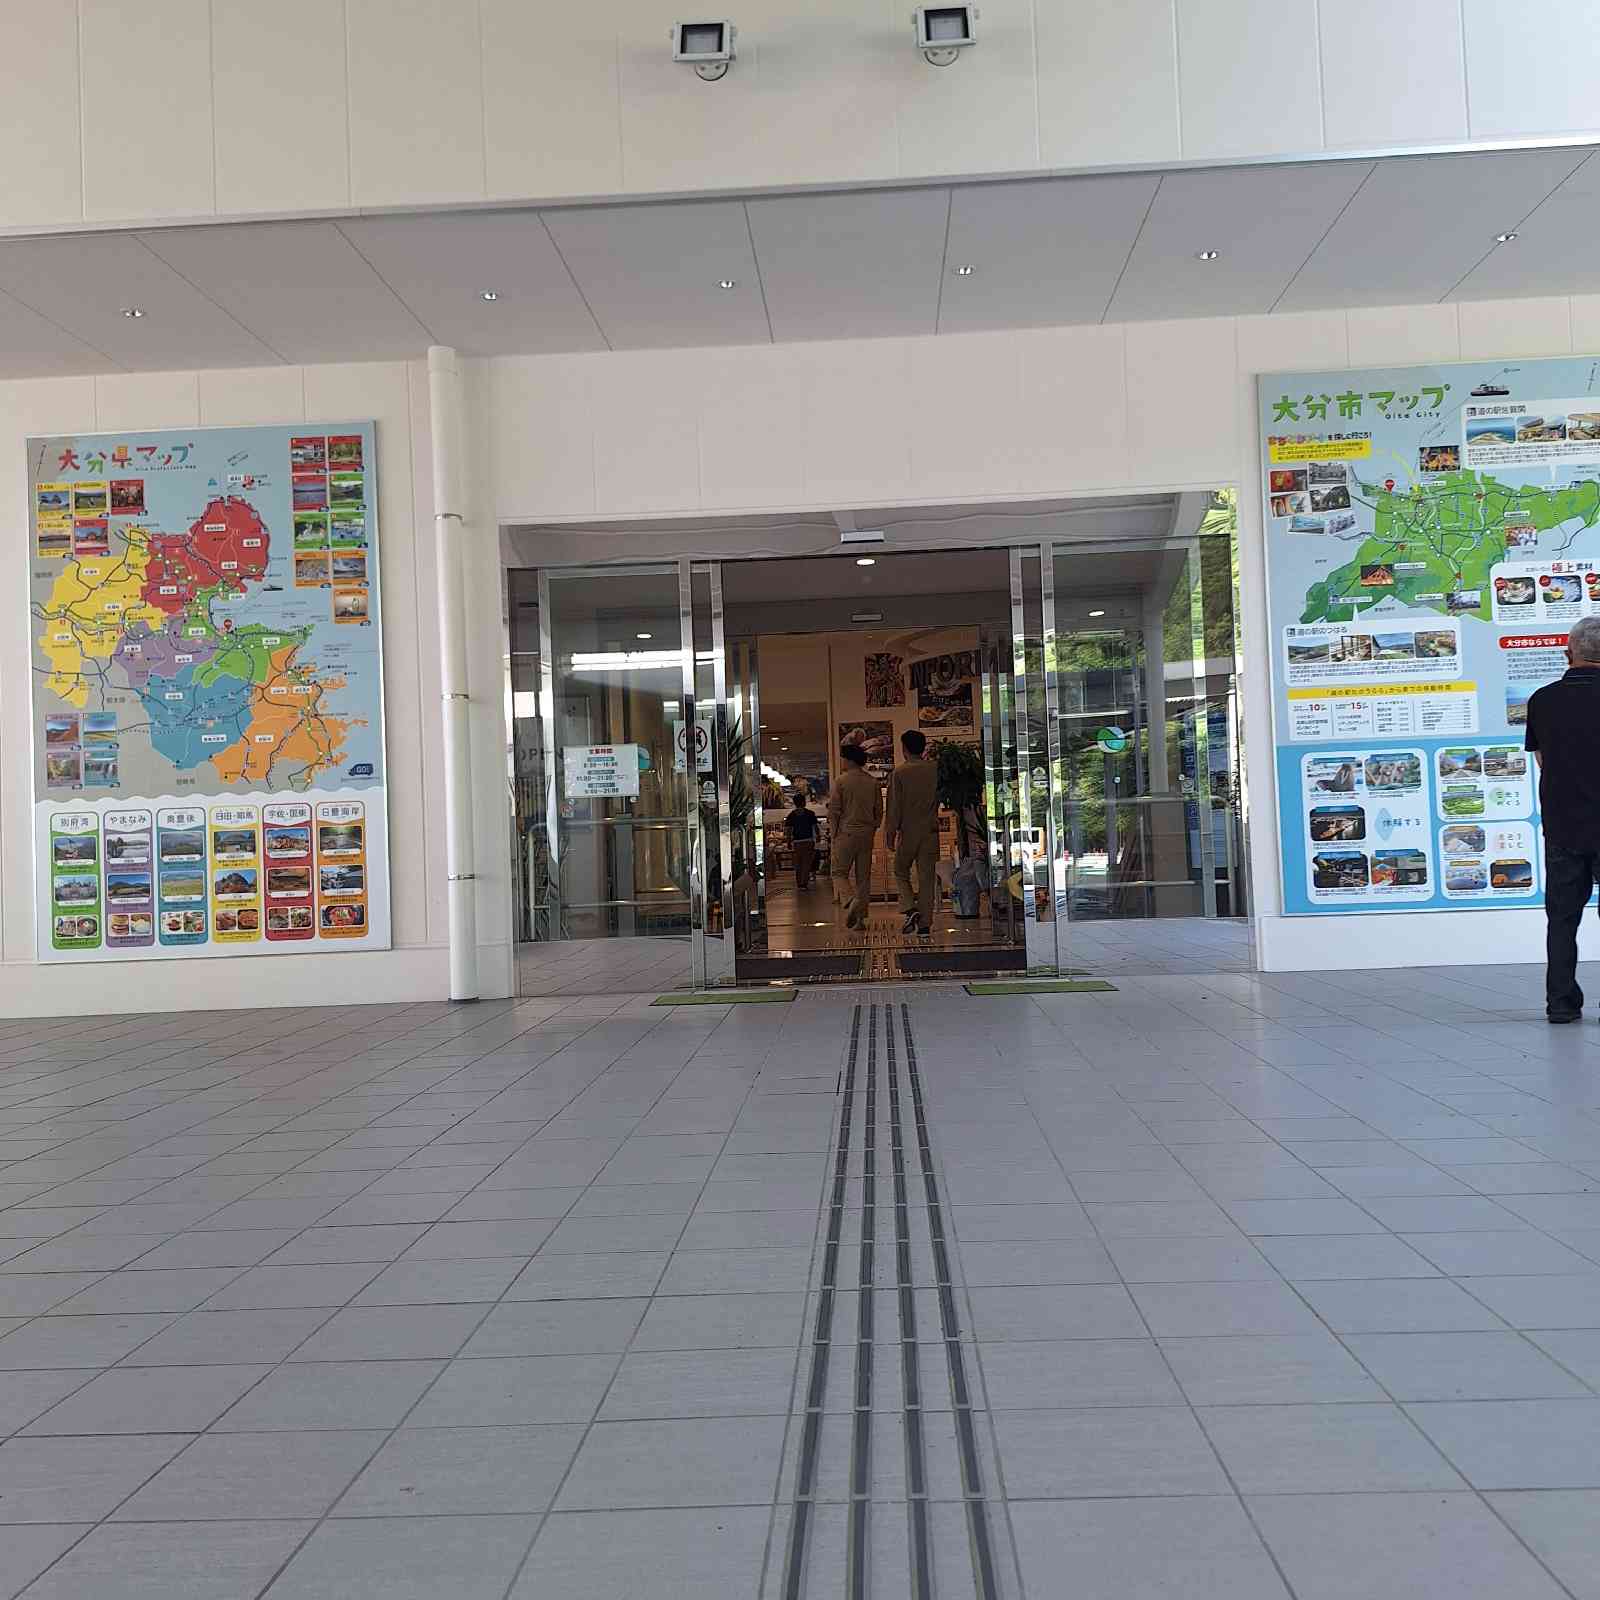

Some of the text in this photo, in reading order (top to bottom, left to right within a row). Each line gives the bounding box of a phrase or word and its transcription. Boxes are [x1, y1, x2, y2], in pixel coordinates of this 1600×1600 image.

[1273, 384, 1451, 422] 大分市マップ
[58, 442, 194, 473] 大分県マップ
[1351, 702, 1362, 710] 15
[110, 815, 146, 825] やまなみ
